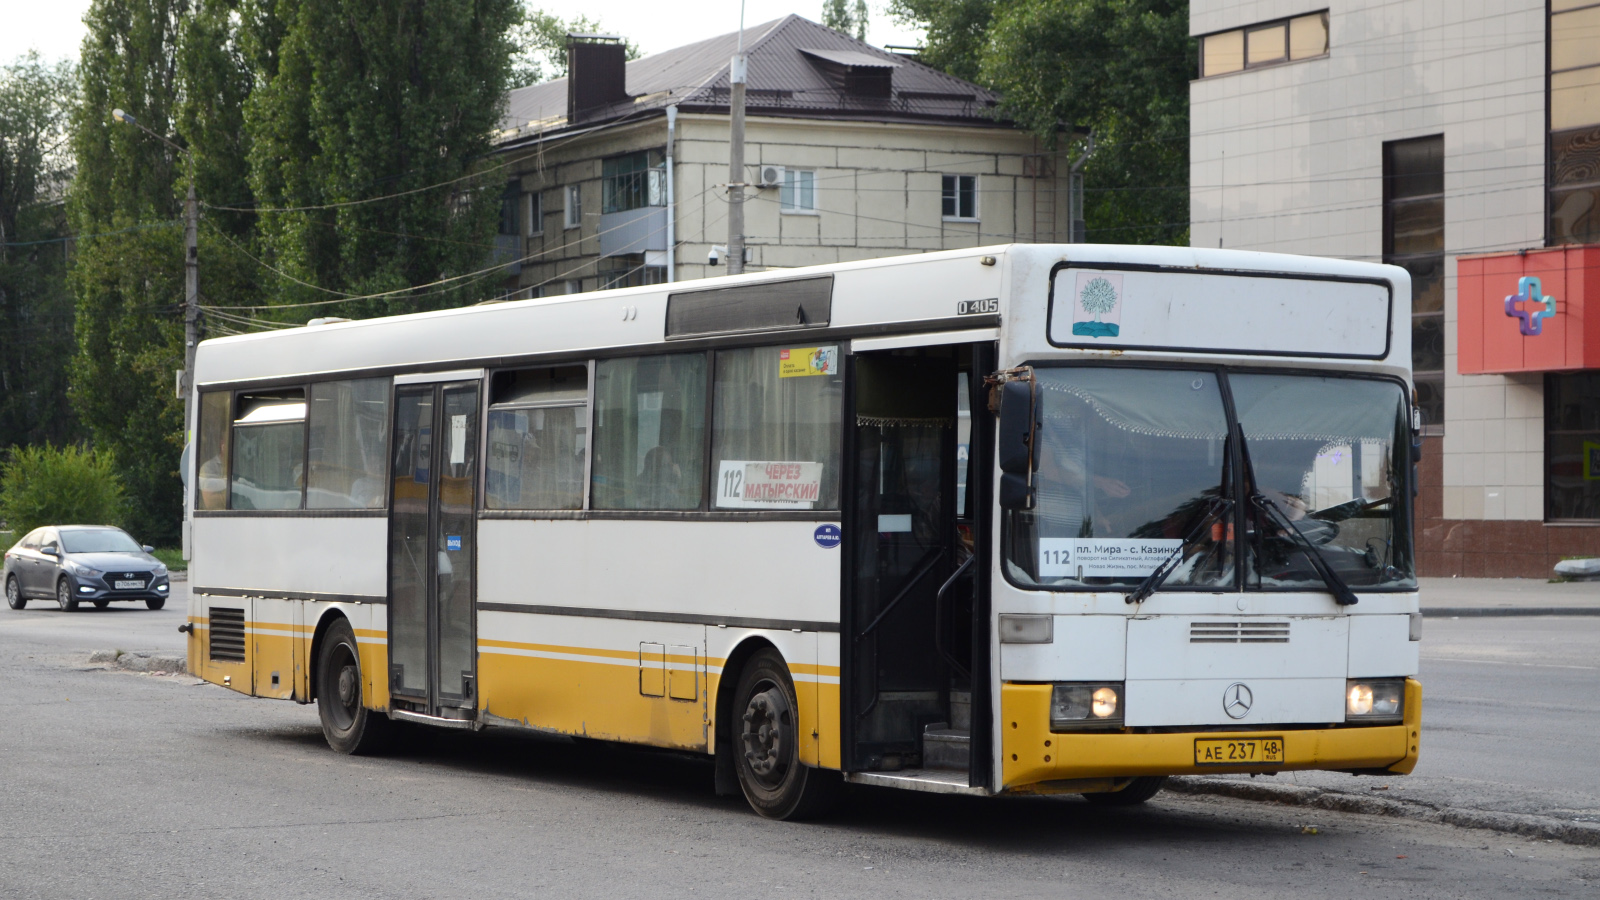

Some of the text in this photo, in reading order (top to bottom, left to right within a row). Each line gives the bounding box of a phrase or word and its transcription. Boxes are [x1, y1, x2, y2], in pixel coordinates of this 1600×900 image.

[970, 299, 998, 313] 405
[765, 463, 802, 480] ЧЕРЕЗ
[723, 469, 742, 498] 112
[744, 480, 819, 499] МАТЫРСКИЙ
[447, 539, 461, 547] ВЫХОД
[1076, 546, 1092, 554] пл.
[1094, 545, 1121, 555] Мира
[1130, 546, 1139, 554] с.
[1043, 549, 1070, 565] 112
[1205, 741, 1278, 760] AE 237 48
